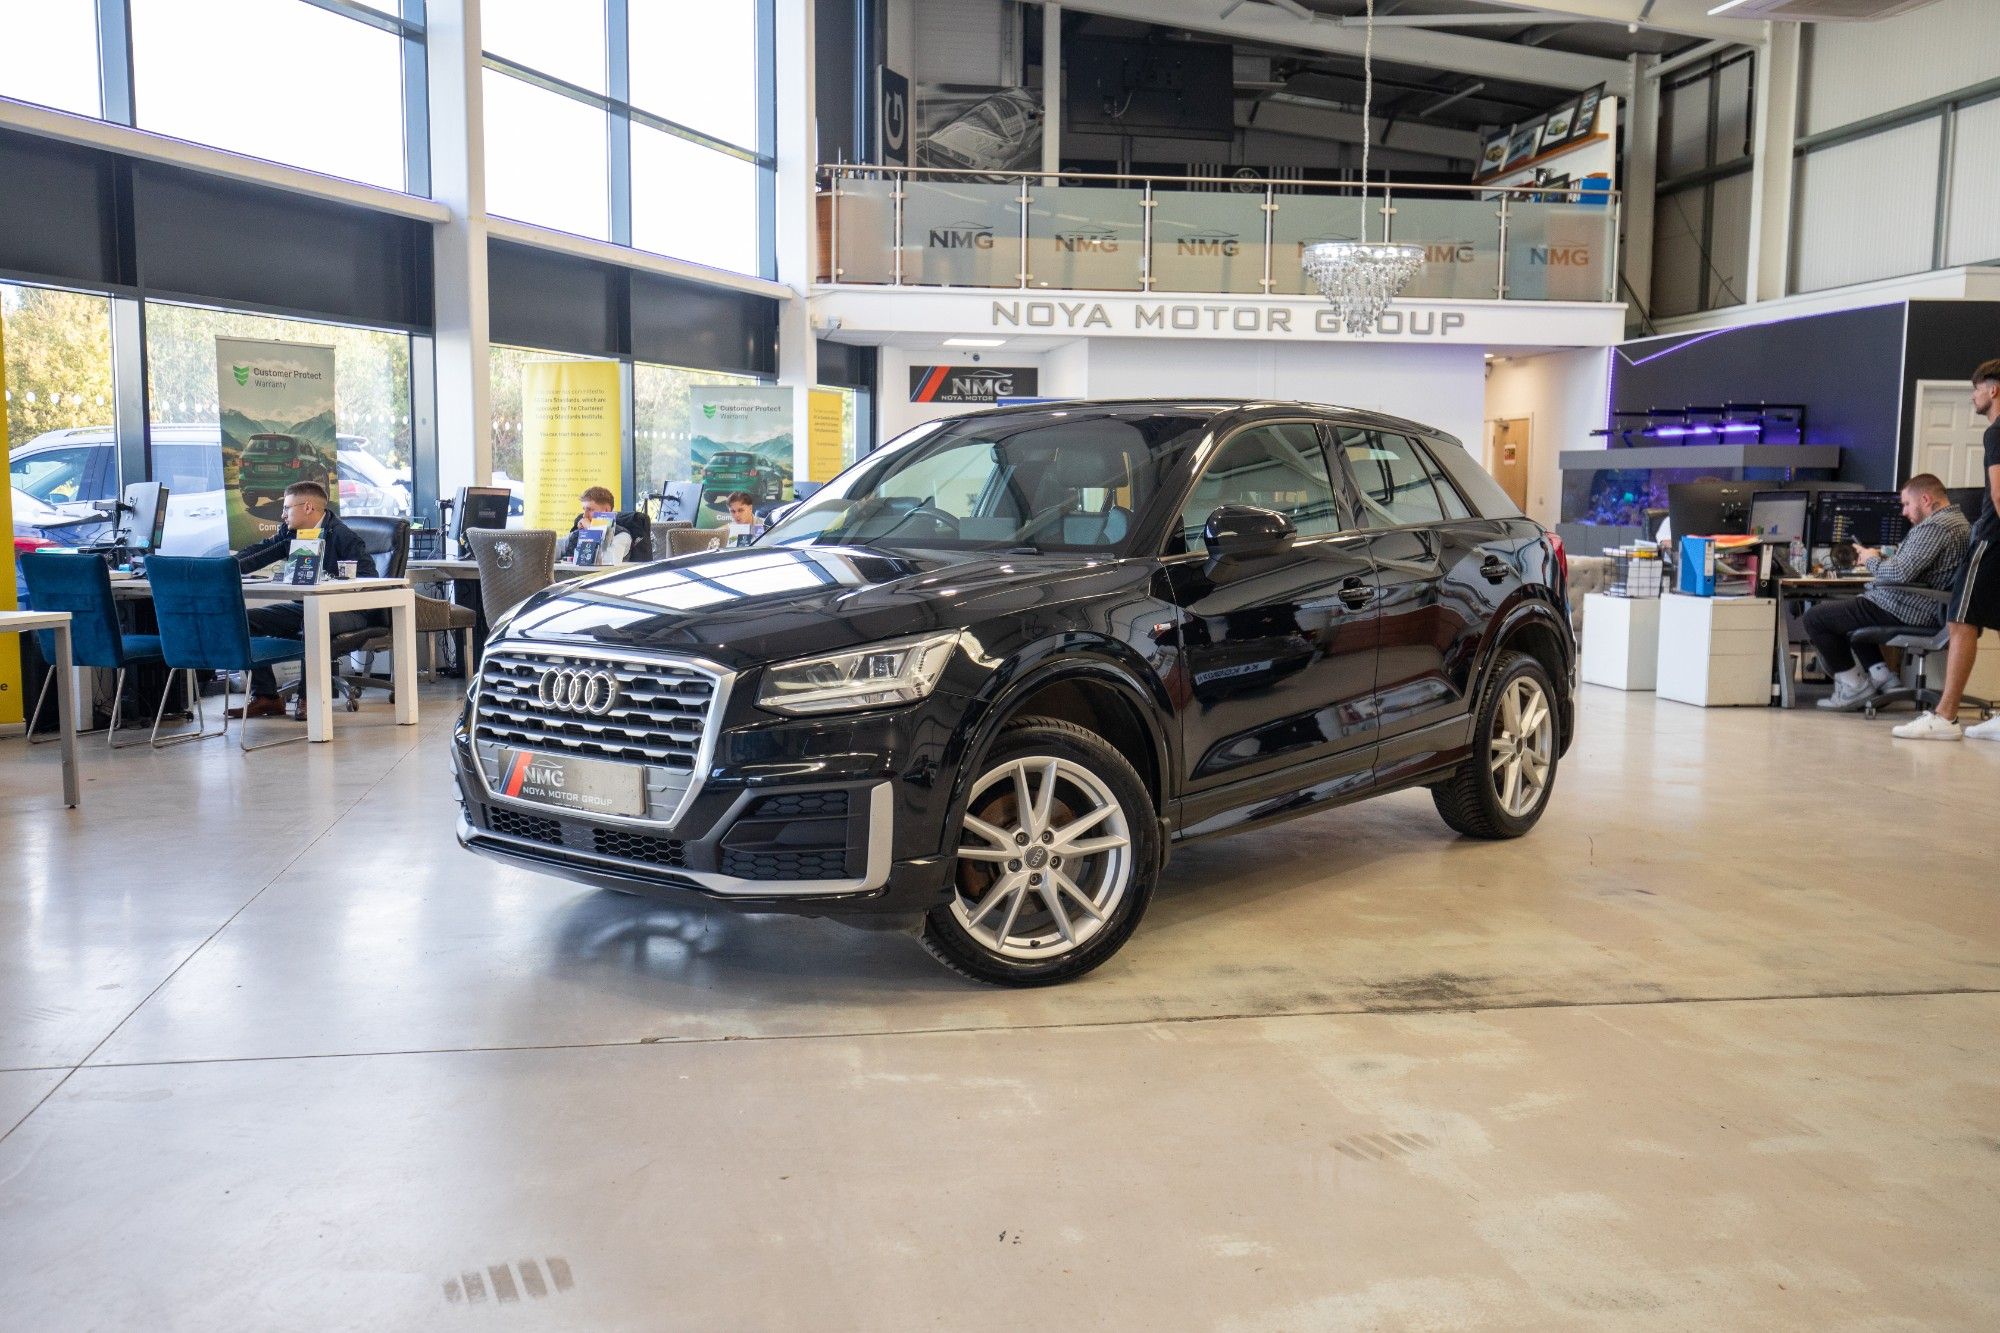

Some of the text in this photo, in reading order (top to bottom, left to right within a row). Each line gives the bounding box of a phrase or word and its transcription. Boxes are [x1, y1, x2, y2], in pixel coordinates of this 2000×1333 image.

[929, 229, 993, 249] NMG
[1054, 233, 1119, 253] NMG
[1177, 238, 1240, 257] NMG
[1529, 247, 1589, 266] NMG
[992, 301, 1465, 336] NOYA MOTOR GOUP
[253, 367, 323, 380] Customer Protect
[254, 380, 287, 389] Warranty
[951, 377, 1014, 396] NMG
[523, 765, 565, 787] NMG
[522, 786, 546, 797] NOYA
[548, 790, 579, 801] MOTOR
[581, 794, 613, 807] GROUP
